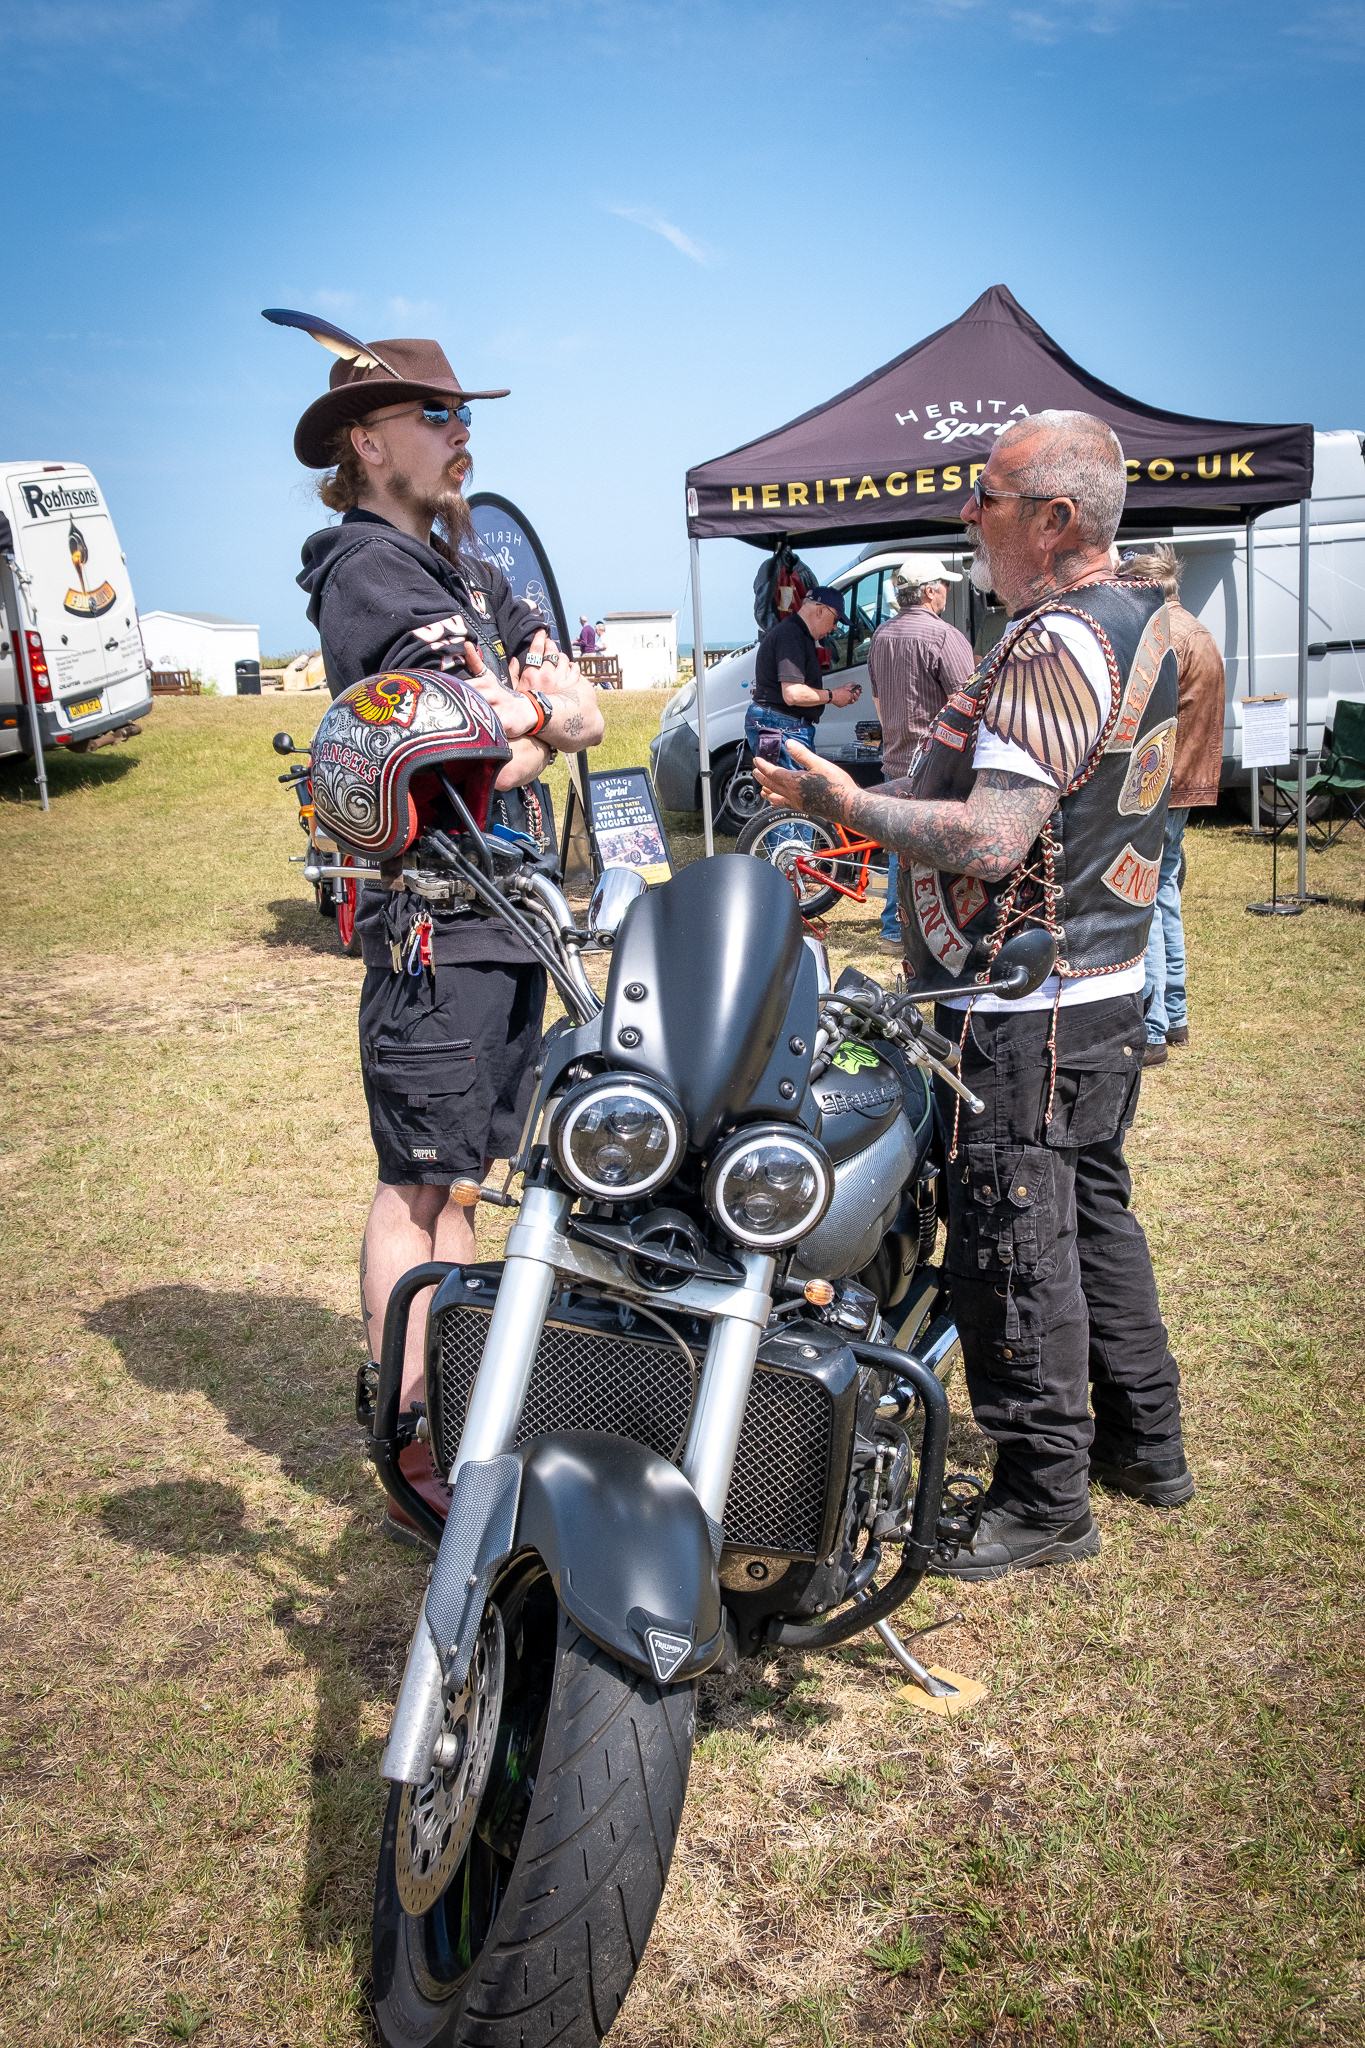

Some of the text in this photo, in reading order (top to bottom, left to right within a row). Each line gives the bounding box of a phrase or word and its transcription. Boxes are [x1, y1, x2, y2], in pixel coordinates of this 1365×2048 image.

[895, 400, 1056, 426] HERITA
[923, 418, 1016, 443] Spri
[22, 485, 97, 518] Robinsons
[1116, 619, 1165, 742] HELLS
[320, 743, 381, 784] ANGELS
[596, 779, 632, 791] HERITAGE
[604, 785, 629, 799] Sprint
[595, 813, 653, 830] AUGUST 2025
[597, 806, 647, 820] 9TH & 10TH
[1110, 853, 1159, 902] ENG
[914, 860, 963, 961] ENT
[412, 1148, 438, 1158] SUPPLY
[654, 1639, 684, 1654] TRIUMPH
